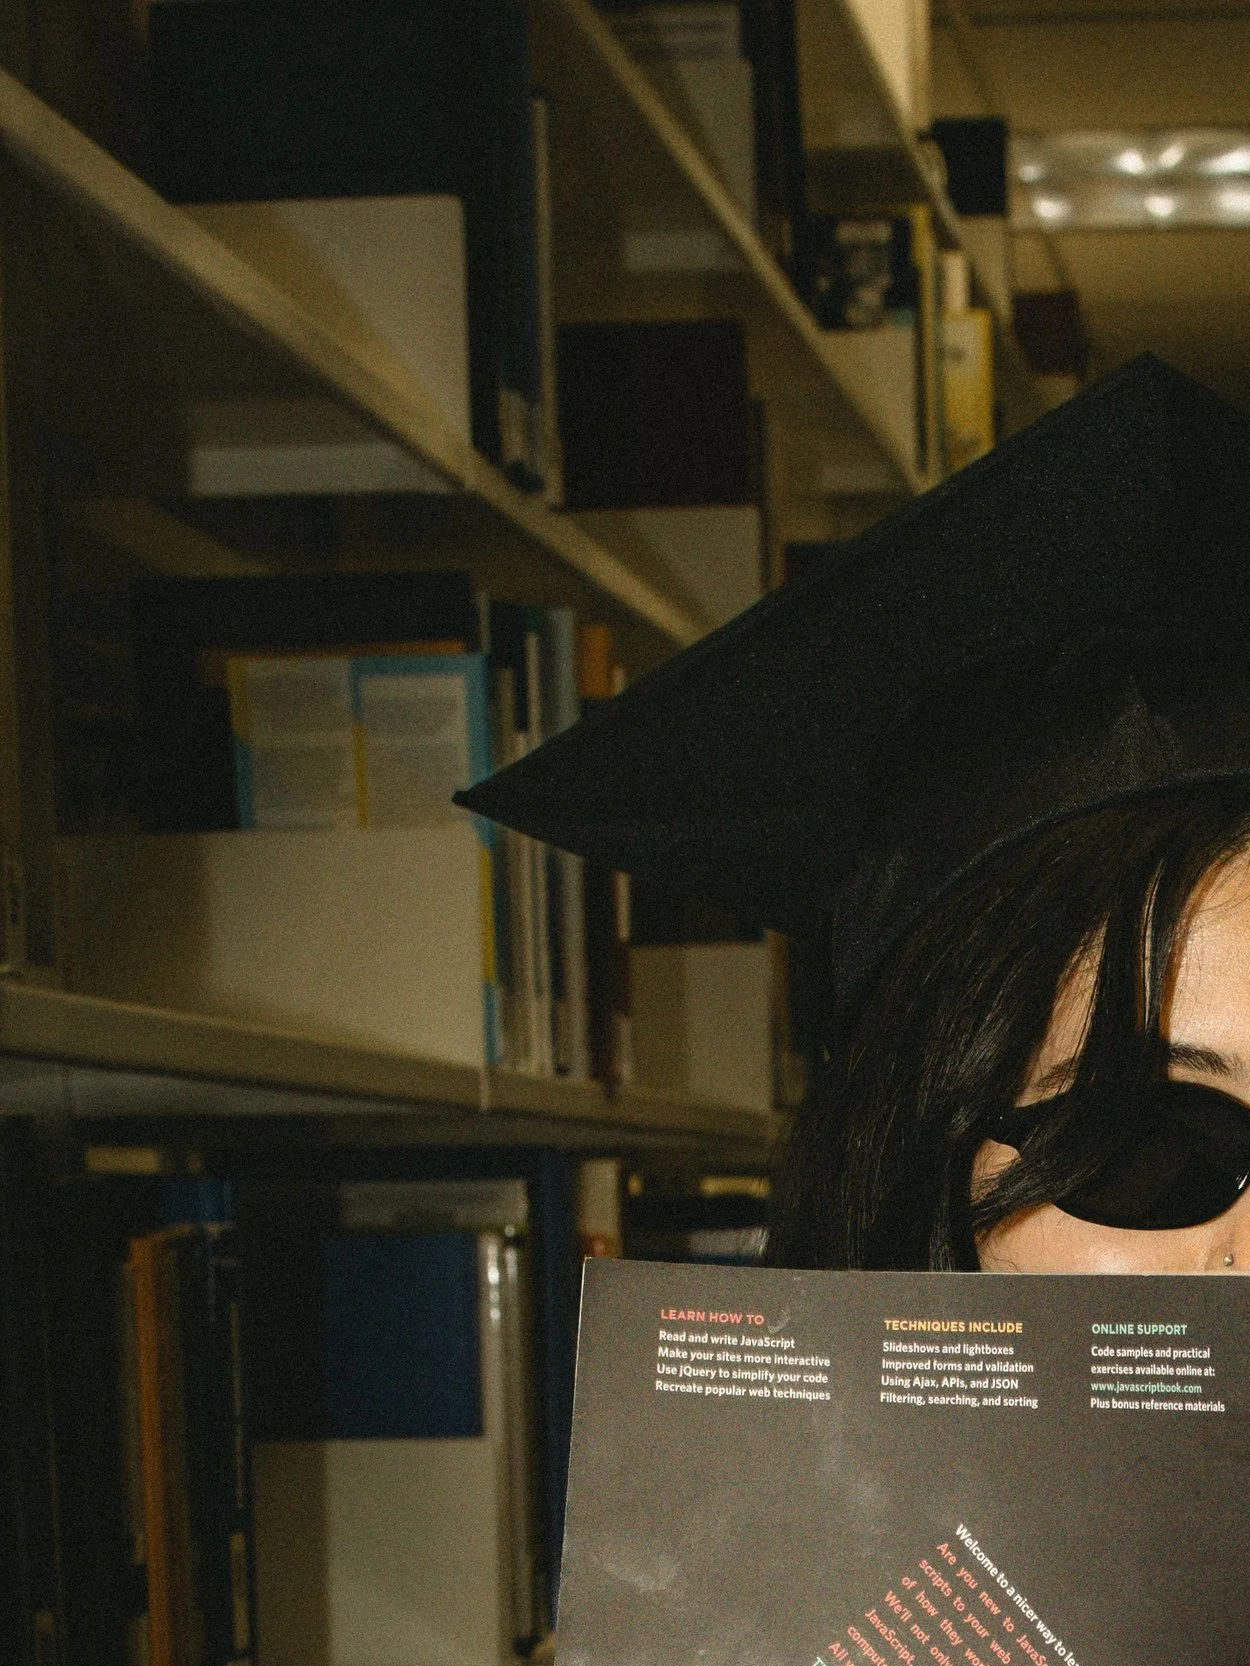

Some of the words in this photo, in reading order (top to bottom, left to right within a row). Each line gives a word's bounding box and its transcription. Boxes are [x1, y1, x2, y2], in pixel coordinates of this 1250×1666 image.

[661, 1309, 706, 1322] LEARN
[709, 1312, 742, 1324] HOW
[747, 1315, 765, 1326] TO
[885, 1320, 966, 1333] TECHNIQUES
[969, 1322, 1023, 1334] INCLUDE
[1092, 1324, 1134, 1335] ONLINE
[1137, 1325, 1188, 1336] SUPPORT
[659, 1331, 686, 1342] Read
[688, 1333, 708, 1344] and
[711, 1335, 738, 1346] write
[740, 1336, 795, 1350] JavaScript
[883, 1342, 940, 1354] Slideshows
[942, 1344, 961, 1354] and
[962, 1344, 1014, 1356] lightboxes
[658, 1347, 688, 1359] Make
[690, 1351, 714, 1362] your
[717, 1351, 742, 1363] sites
[744, 1355, 772, 1364] more
[774, 1354, 831, 1367] interactive
[1091, 1346, 1115, 1357] Code
[1117, 1346, 1154, 1359] samples
[1155, 1348, 1172, 1358] and
[1173, 1348, 1211, 1360] practical
[657, 1364, 678, 1375] Use
[679, 1365, 717, 1378] jQuery
[719, 1368, 730, 1378] to
[732, 1369, 775, 1382] simplify
[777, 1373, 801, 1384] your
[803, 1372, 829, 1384] code
[882, 1359, 931, 1371] Improved
[932, 1360, 963, 1372] forms
[964, 1361, 984, 1372] and
[986, 1361, 1034, 1373] validation
[1091, 1364, 1134, 1374] exercises
[1135, 1365, 1175, 1375] available
[1176, 1366, 1202, 1376] online
[1204, 1367, 1216, 1376] at:
[656, 1380, 703, 1394] Recreate
[705, 1384, 746, 1397] popular
[749, 1386, 771, 1398] web
[773, 1388, 831, 1402] techniques
[881, 1376, 911, 1388] Using
[913, 1376, 939, 1389] Ajax,
[941, 1377, 968, 1390] APIs,
[970, 1379, 989, 1389] and
[991, 1379, 1019, 1390] JSON
[1091, 1381, 1202, 1394] www.javascriptbook.com
[880, 1392, 926, 1406] Filtering,
[928, 1394, 980, 1408] searching,
[982, 1396, 1002, 1406] and
[1003, 1396, 1039, 1409] sorting
[1091, 1398, 1110, 1409] Plus
[1112, 1399, 1140, 1410] bonus
[1141, 1399, 1184, 1411] reference
[1185, 1401, 1226, 1412] materials
[936, 1542, 956, 1565] Are
[956, 1567, 978, 1589] you
[978, 1591, 1001, 1615] new
[1002, 1616, 1014, 1632] to
[955, 1523, 998, 1577] Welcome
[996, 1572, 1008, 1588] to
[1006, 1586, 1015, 1596] a
[1012, 1593, 1038, 1621] nicer
[1036, 1620, 1056, 1644] way
[1054, 1640, 1066, 1656] to
[901, 1576, 917, 1589] of
[915, 1590, 938, 1616] how
[939, 1618, 963, 1646] they
[918, 1559, 952, 1597] scripts
[953, 1596, 965, 1611] to
[963, 1613, 990, 1638] your
[990, 1640, 1010, 1664] web
[910, 1623, 930, 1644] not
